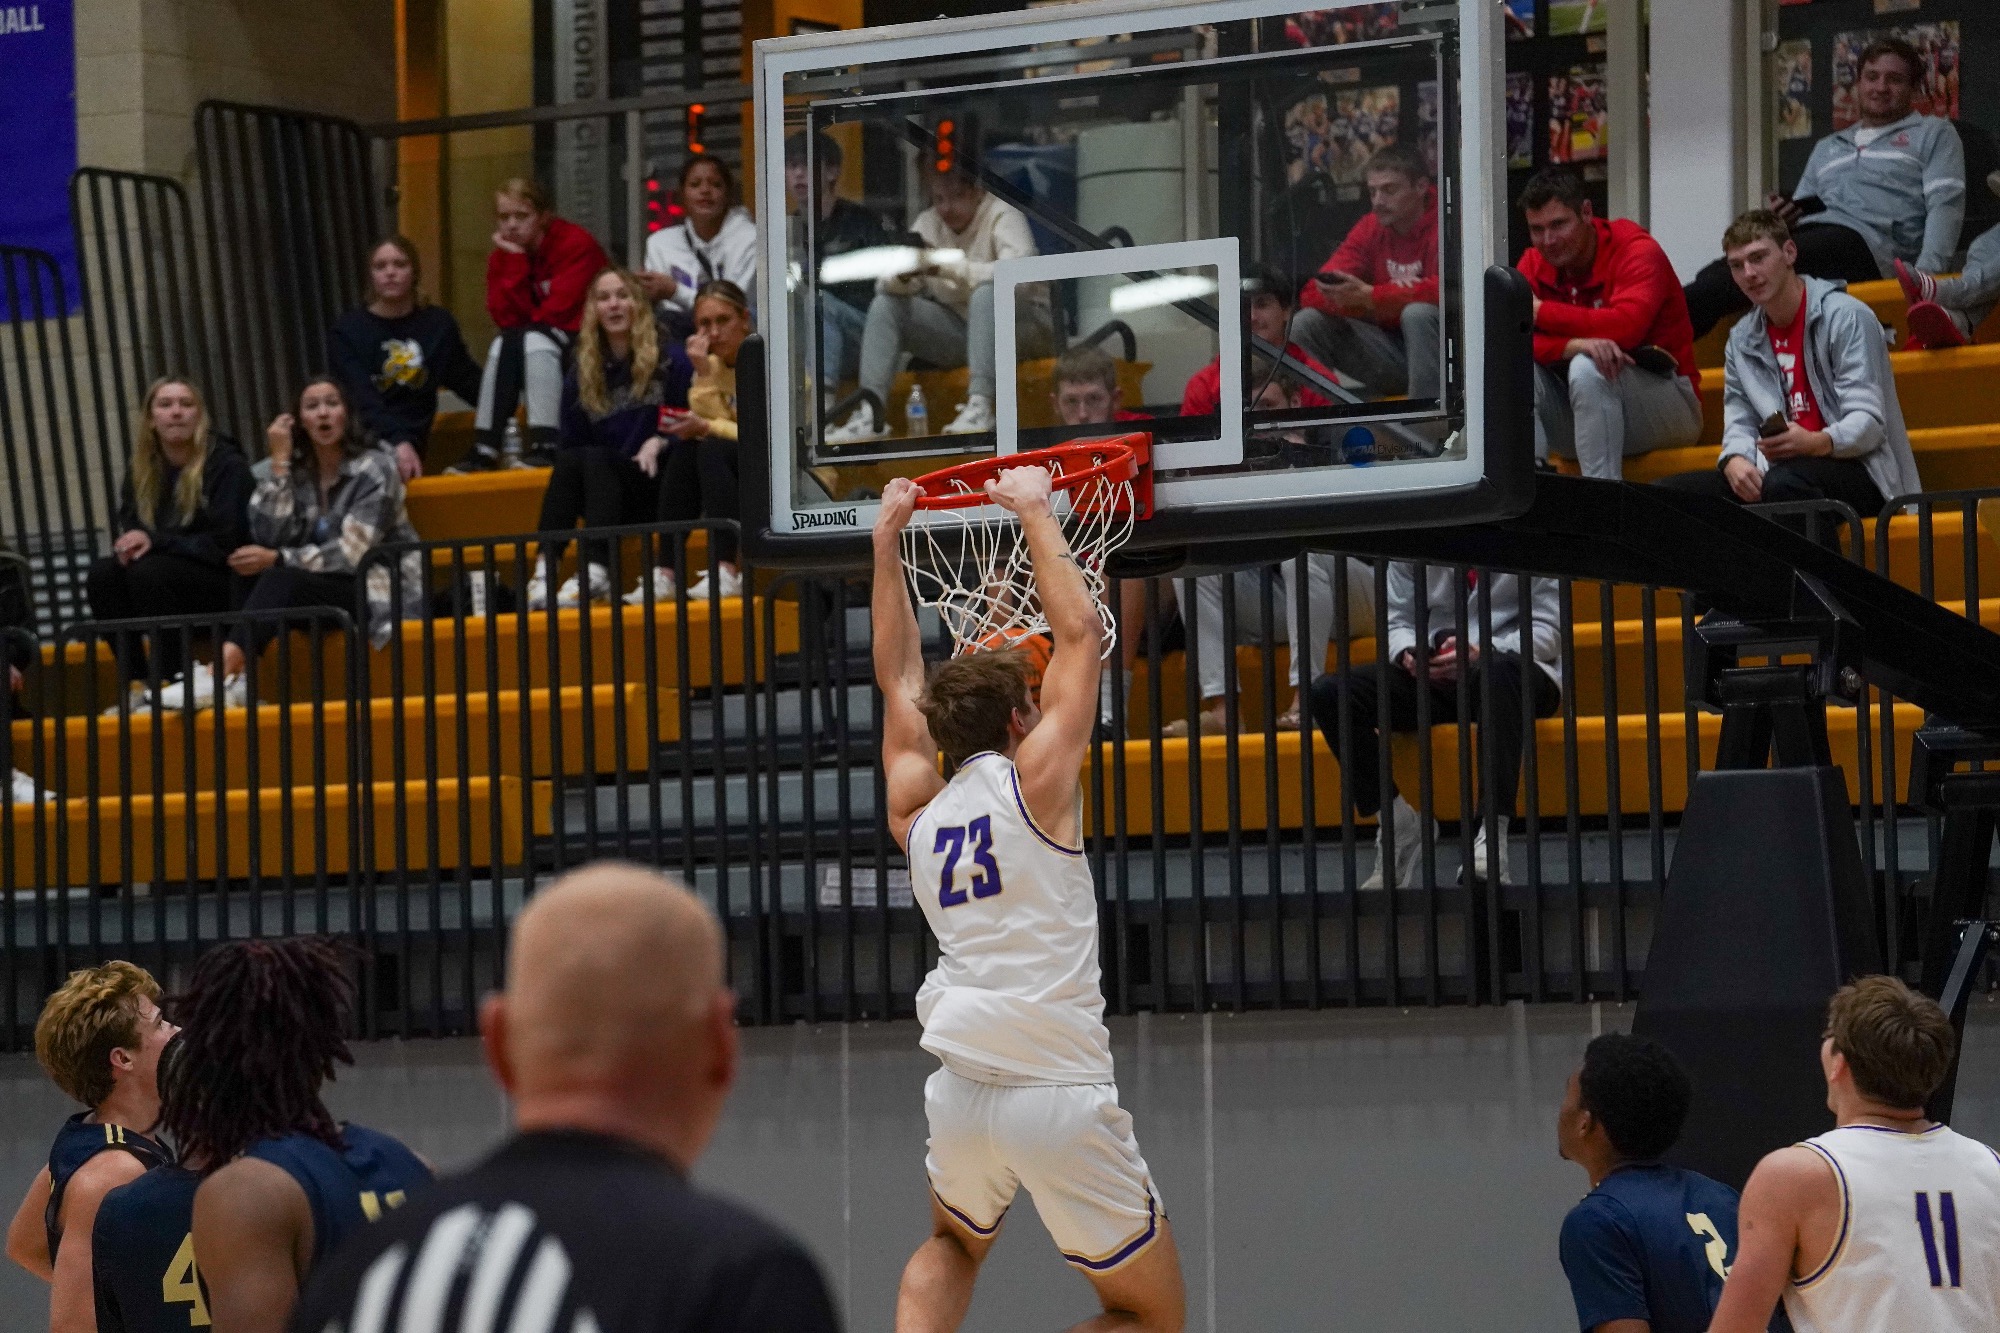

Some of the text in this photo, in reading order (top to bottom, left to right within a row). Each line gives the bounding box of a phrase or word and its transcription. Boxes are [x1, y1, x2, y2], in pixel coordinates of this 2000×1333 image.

[1377, 443, 1413, 455] Division
[792, 508, 857, 531] SPALDING
[933, 814, 1002, 909] 23
[163, 1231, 212, 1326] 4
[1914, 1191, 1961, 1288] 11
